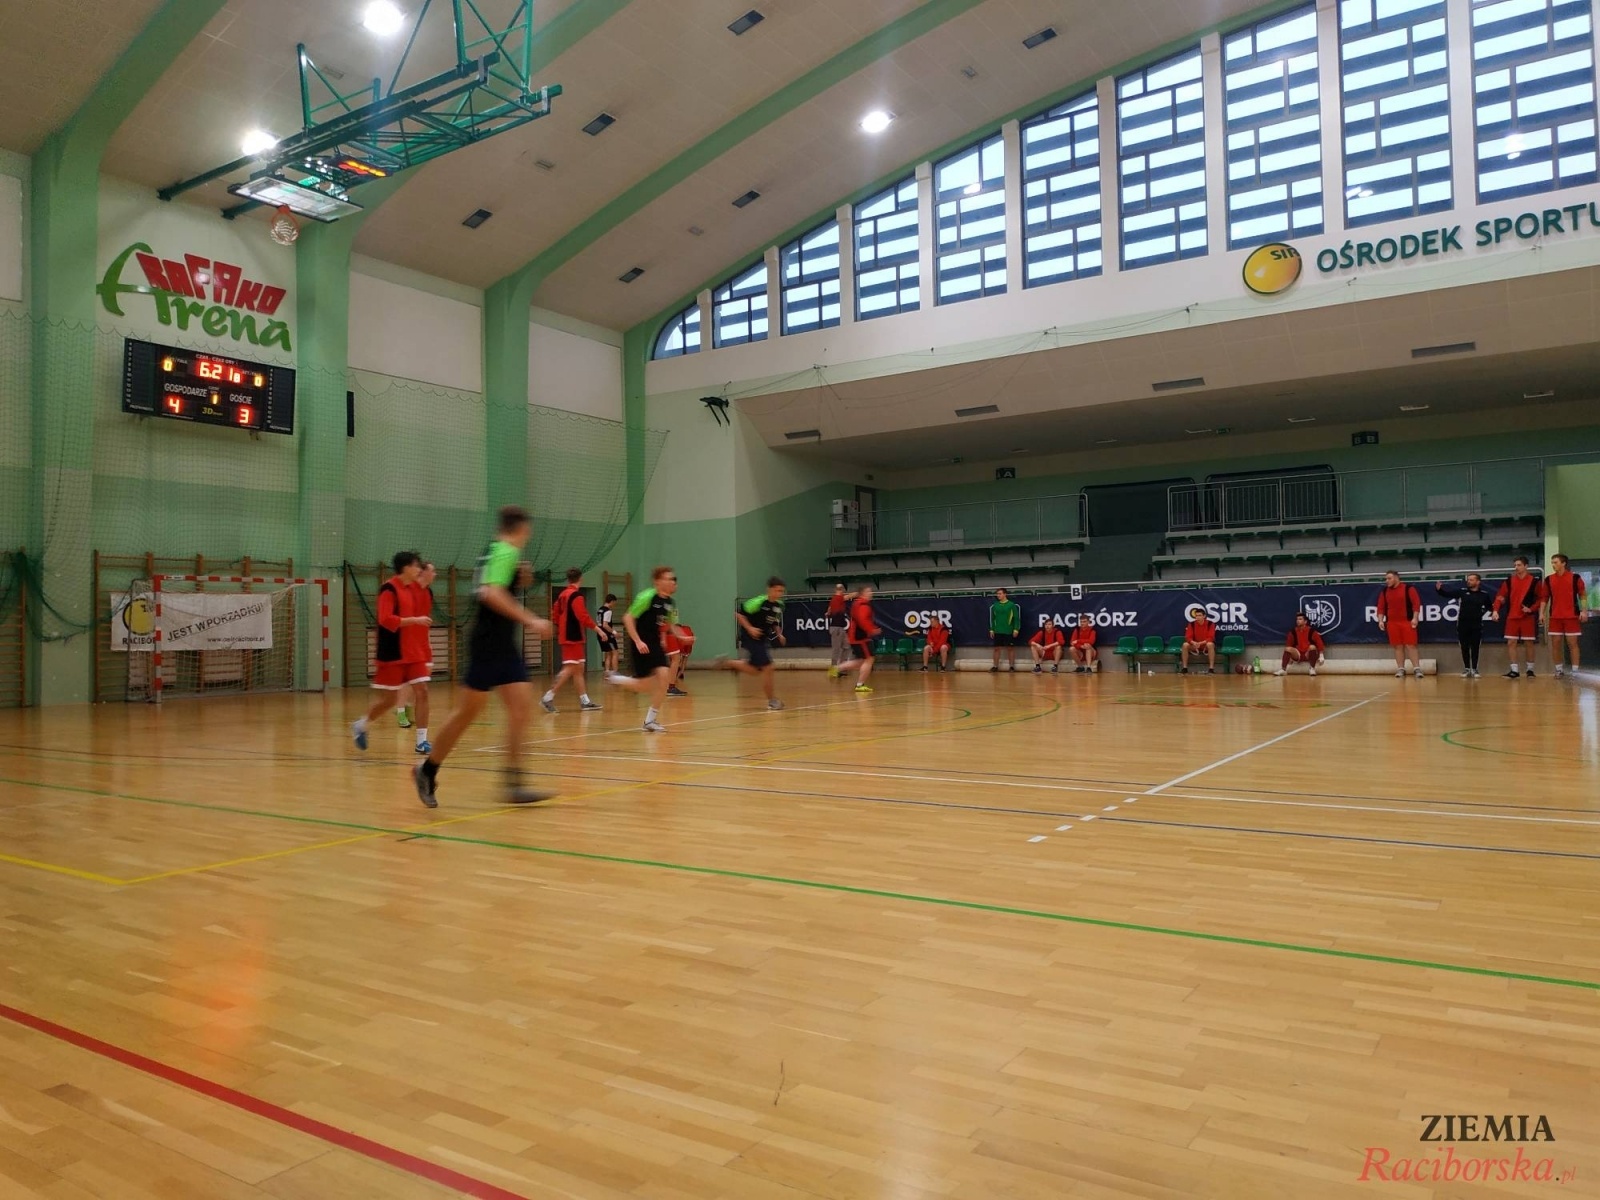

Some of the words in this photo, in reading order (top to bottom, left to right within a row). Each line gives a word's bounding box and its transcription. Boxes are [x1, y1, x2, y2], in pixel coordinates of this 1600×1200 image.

[1316, 225, 1463, 273] OŚRODEK
[96, 242, 292, 351] Arena
[164, 382, 208, 397] GOSPODARZE
[169, 398, 180, 413] 4
[229, 392, 252, 404] GOŚCIE
[239, 408, 250, 423] 3
[1072, 587, 1081, 597] B
[167, 625, 193, 641] JEST
[1214, 622, 1249, 631] ACIBÓRZ
